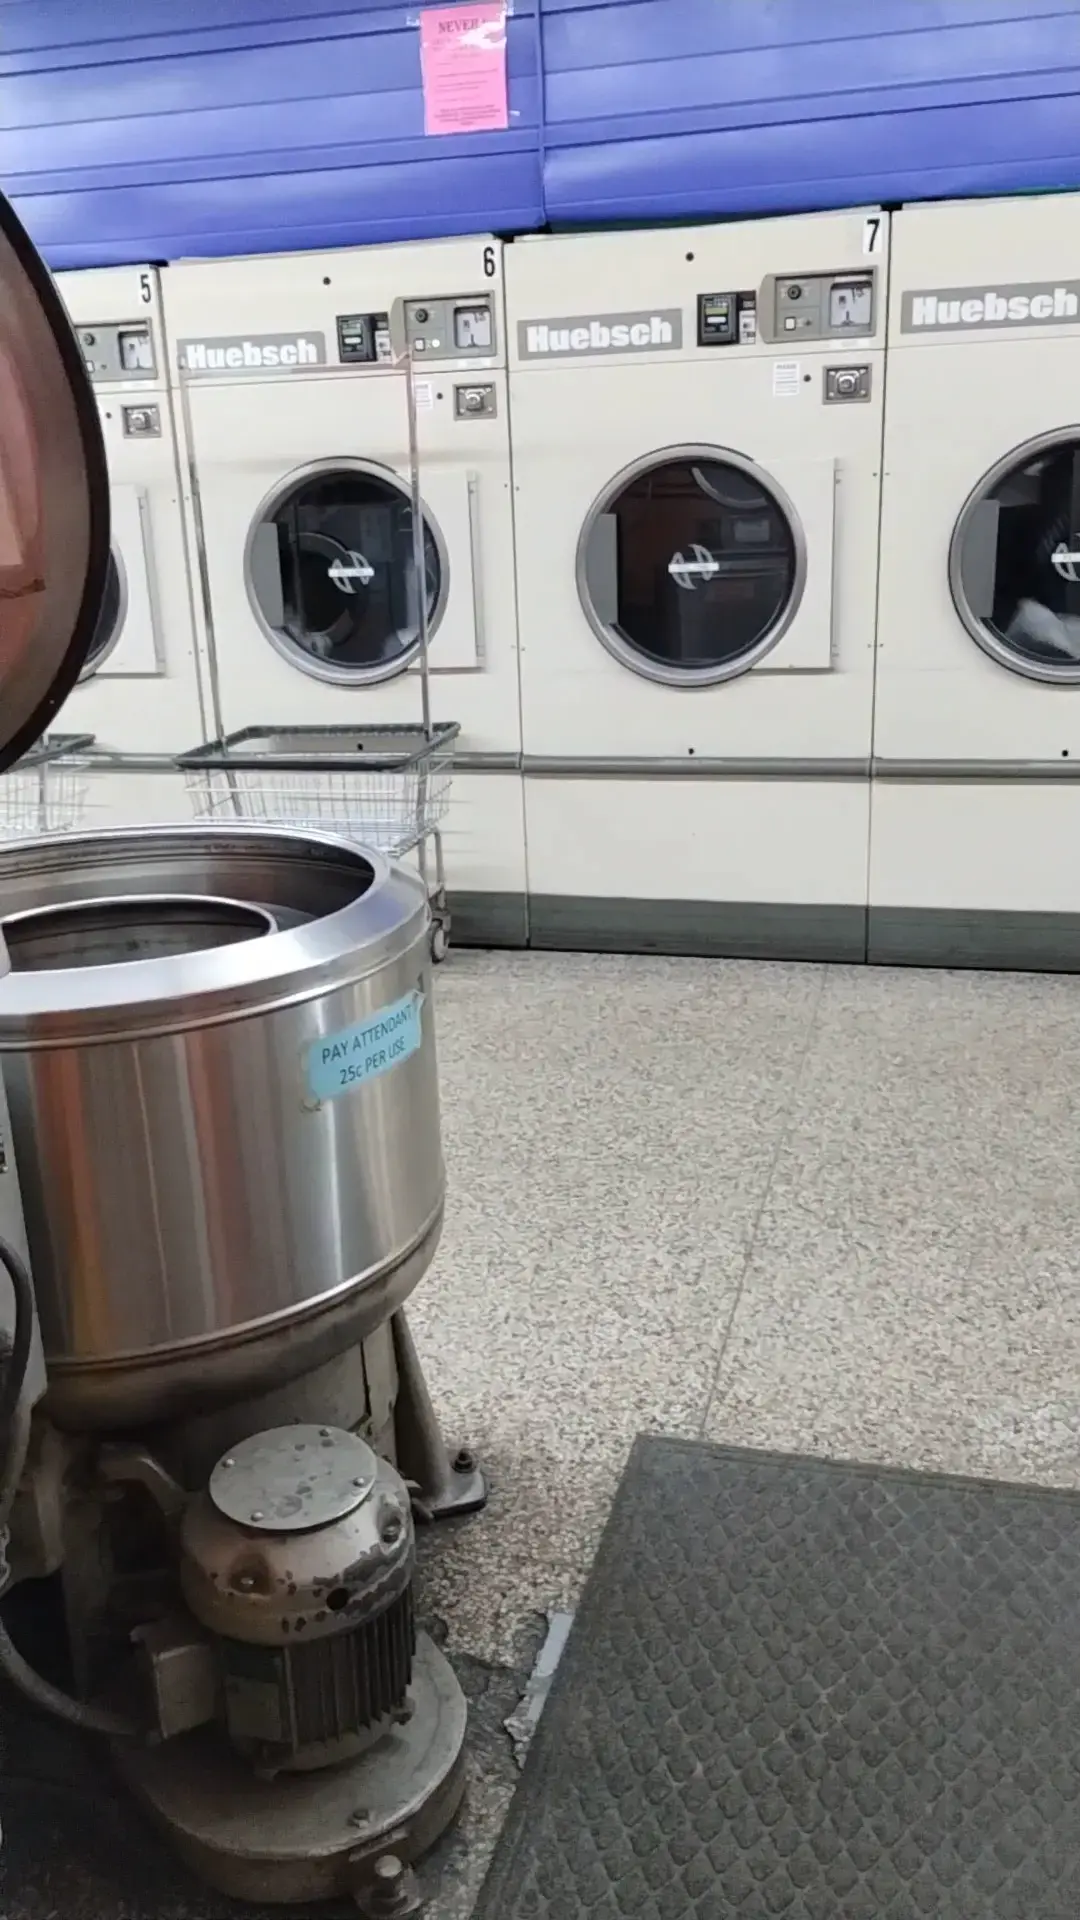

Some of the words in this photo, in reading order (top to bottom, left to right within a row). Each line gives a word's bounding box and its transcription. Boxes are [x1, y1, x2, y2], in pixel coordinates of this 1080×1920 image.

[867, 219, 880, 252] 7
[484, 246, 495, 277] 6
[140, 274, 151, 303] 5
[912, 287, 1078, 326] Huebsch
[526, 316, 673, 353] Huebsch
[185, 338, 317, 369] Huebsch
[321, 1039, 349, 1064] PAY
[352, 1004, 412, 1052] ATTENDANT
[364, 1049, 387, 1074] PER
[388, 1036, 406, 1059] USE
